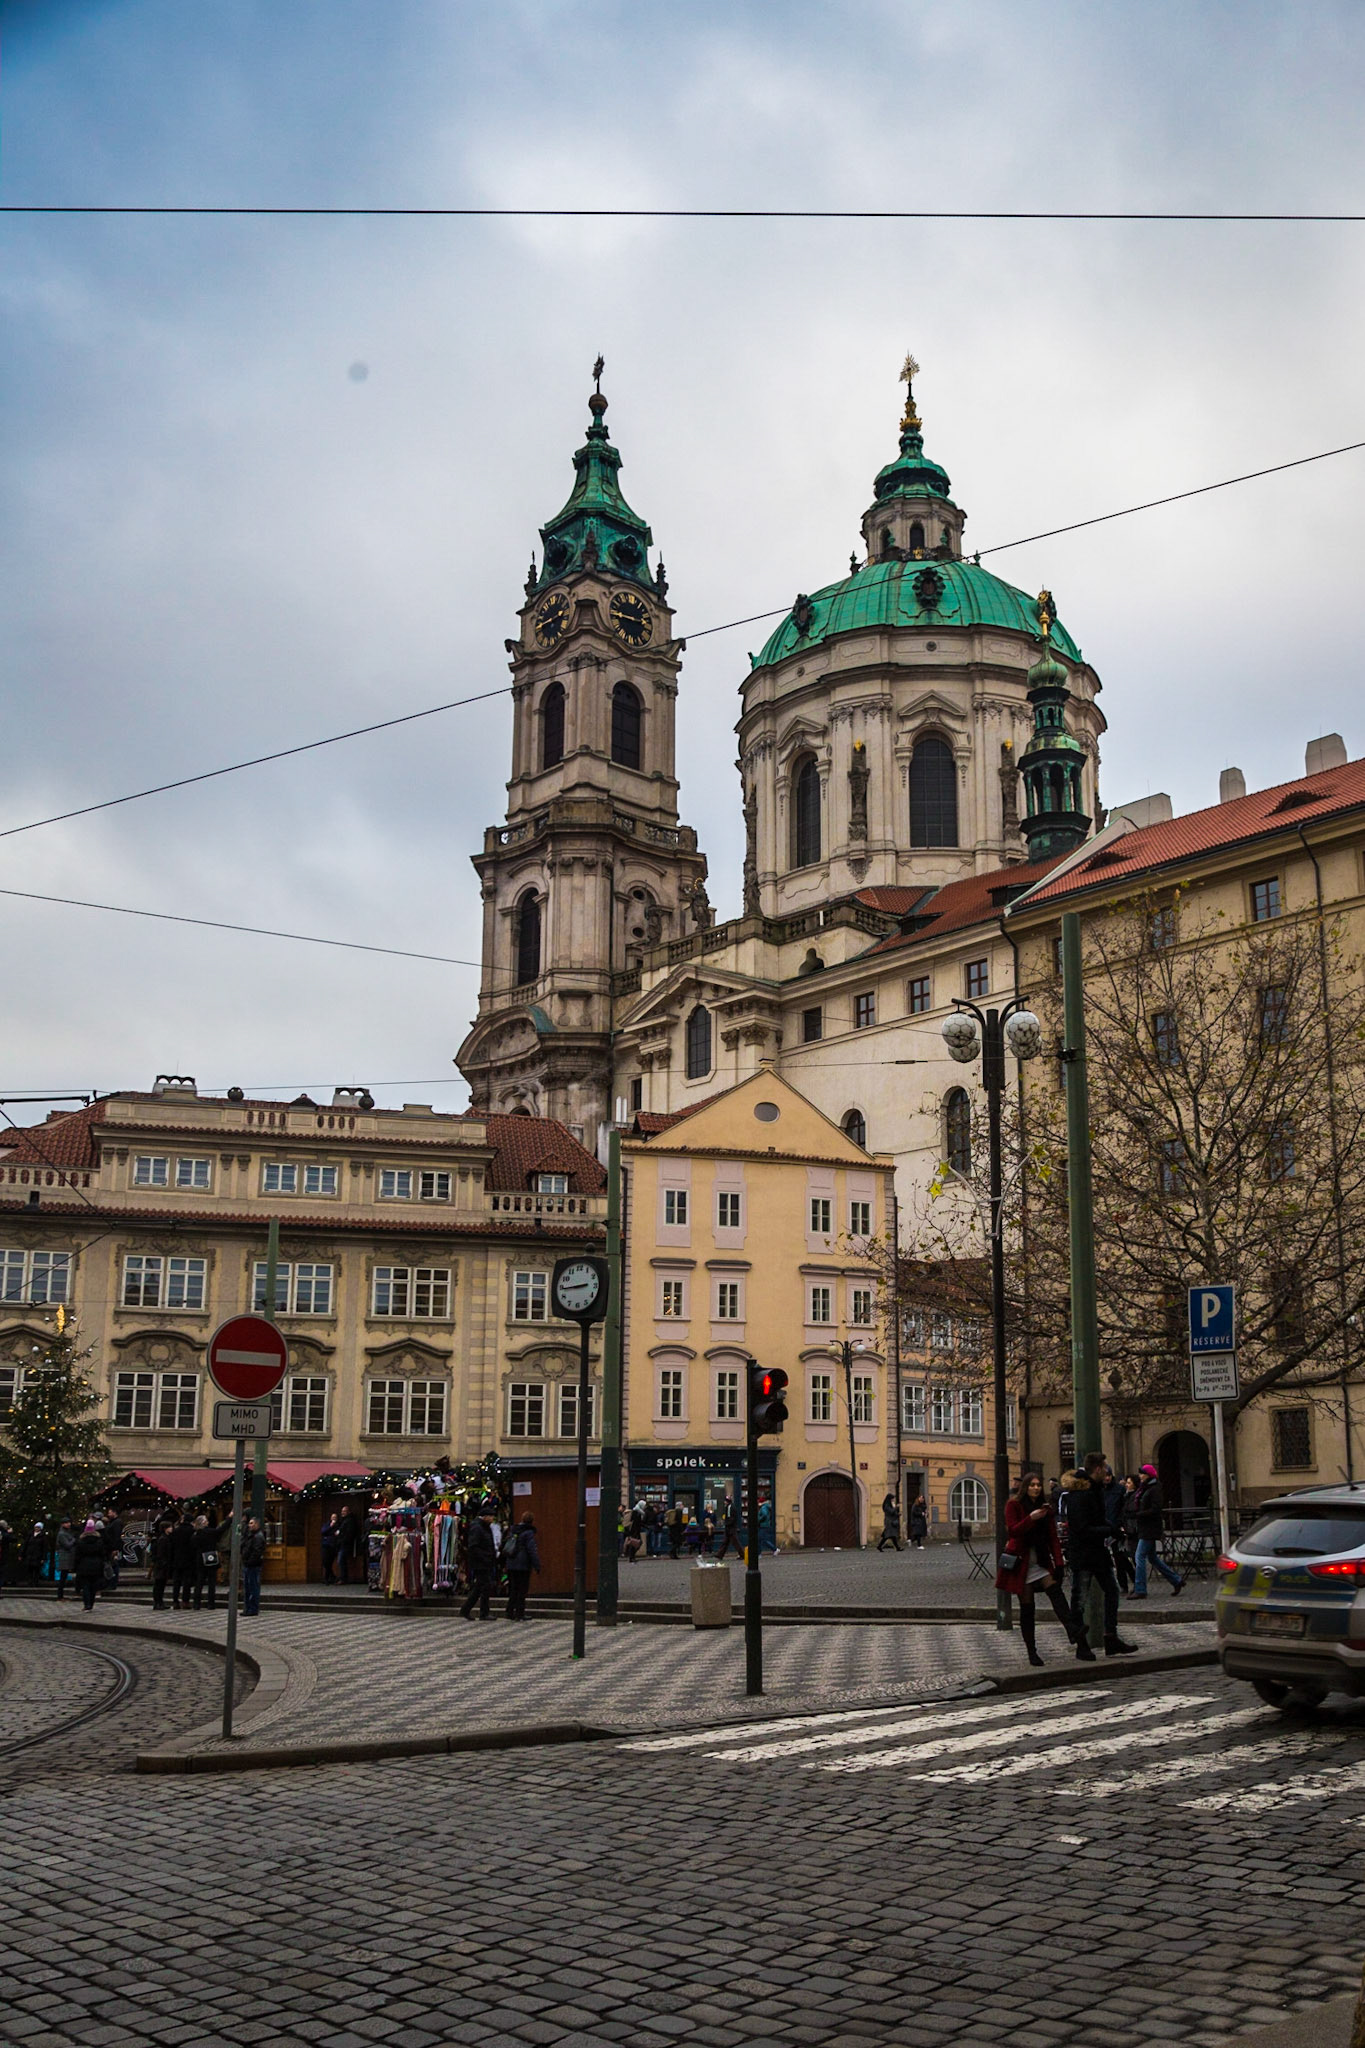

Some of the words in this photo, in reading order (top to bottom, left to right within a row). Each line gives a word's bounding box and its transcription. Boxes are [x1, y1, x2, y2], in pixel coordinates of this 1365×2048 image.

[1201, 1292, 1221, 1328] P
[230, 1408, 259, 1419] MIMO
[231, 1423, 256, 1434] MHD
